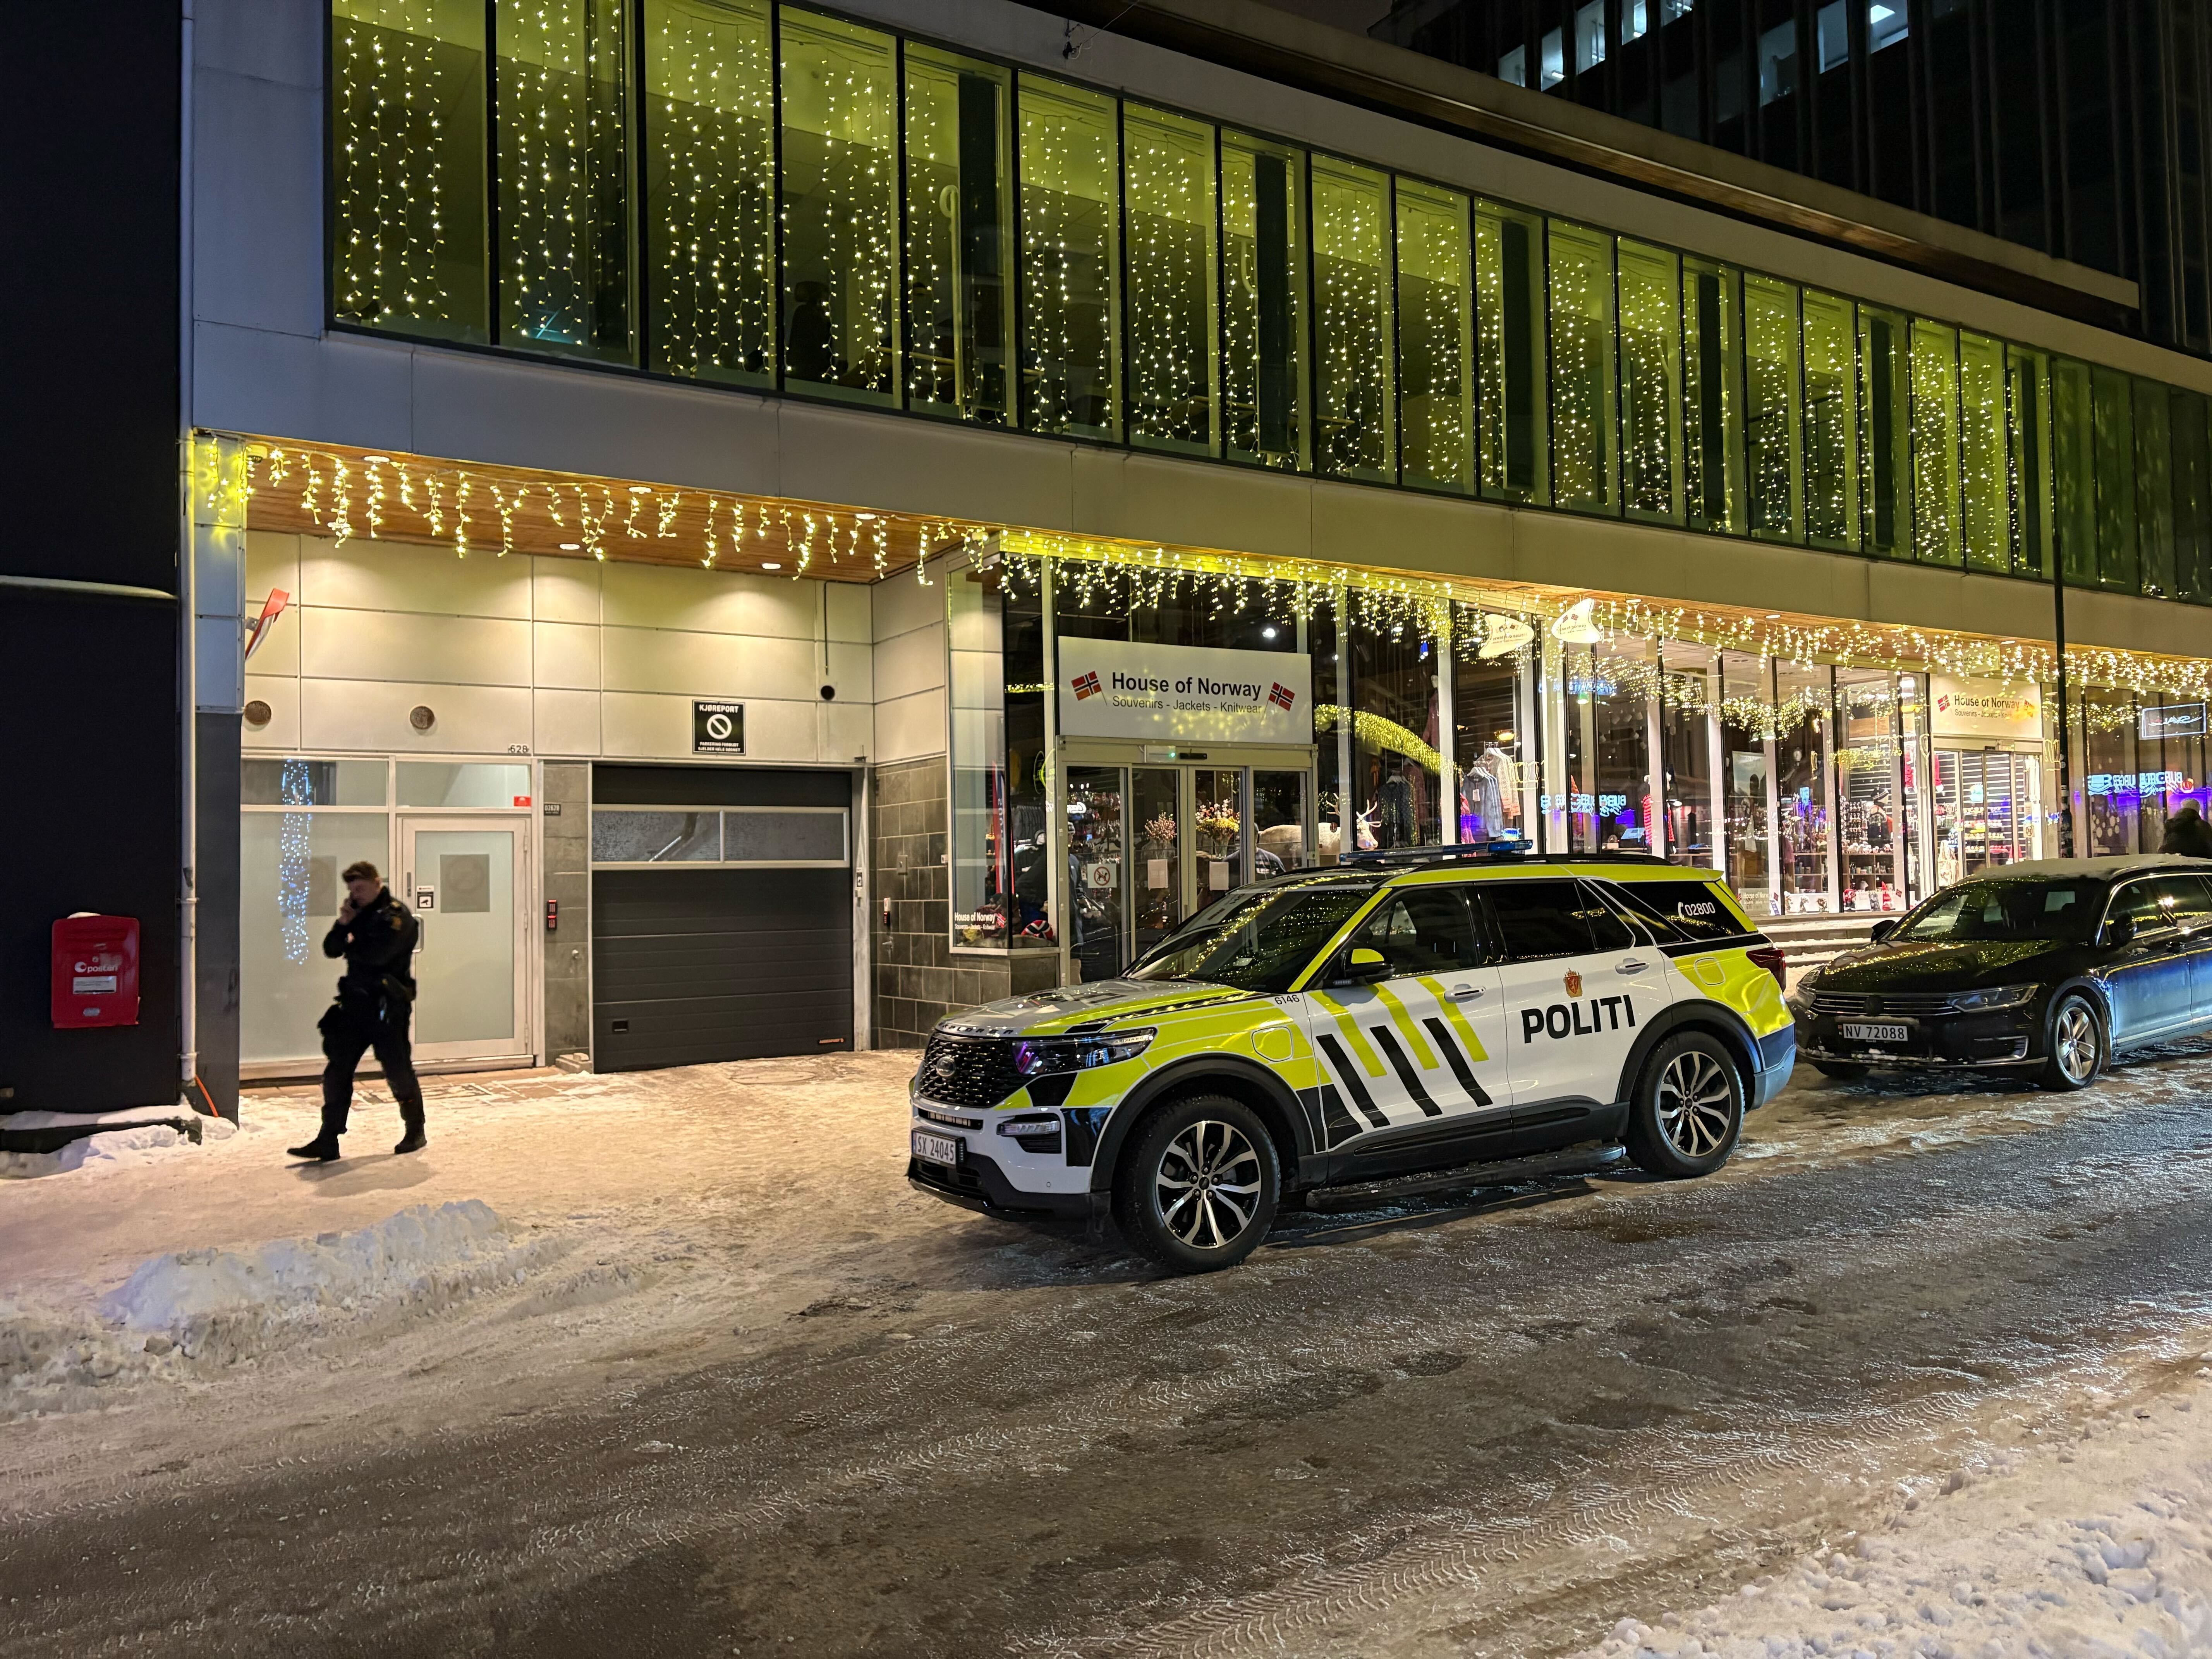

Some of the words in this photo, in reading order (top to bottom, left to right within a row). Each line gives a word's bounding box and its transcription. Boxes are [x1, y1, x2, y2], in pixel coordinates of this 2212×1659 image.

[1112, 672, 1169, 692] House
[1175, 677, 1193, 694] of
[1198, 678, 1261, 701] Norway
[699, 704, 739, 713] KJØREPORT
[1113, 696, 1163, 709] Souvenirs
[1173, 699, 1211, 711] Jackets
[1220, 702, 1262, 713] Knitwear
[1954, 695, 1979, 707] House
[1981, 698, 1989, 707] of
[1991, 697, 2020, 712] Norway
[1955, 709, 1977, 717] Souvenirs
[1685, 902, 1716, 916] 02800
[954, 912, 970, 921] House
[970, 912, 976, 921] of
[976, 912, 995, 924] Norway
[1274, 994, 1300, 1005] 6146
[1521, 994, 1636, 1044] POLITI
[1846, 1025, 1860, 1037] NV
[1866, 1027, 1905, 1039] 72088
[918, 1135, 927, 1154] SX
[930, 1139, 954, 1161] 24045
